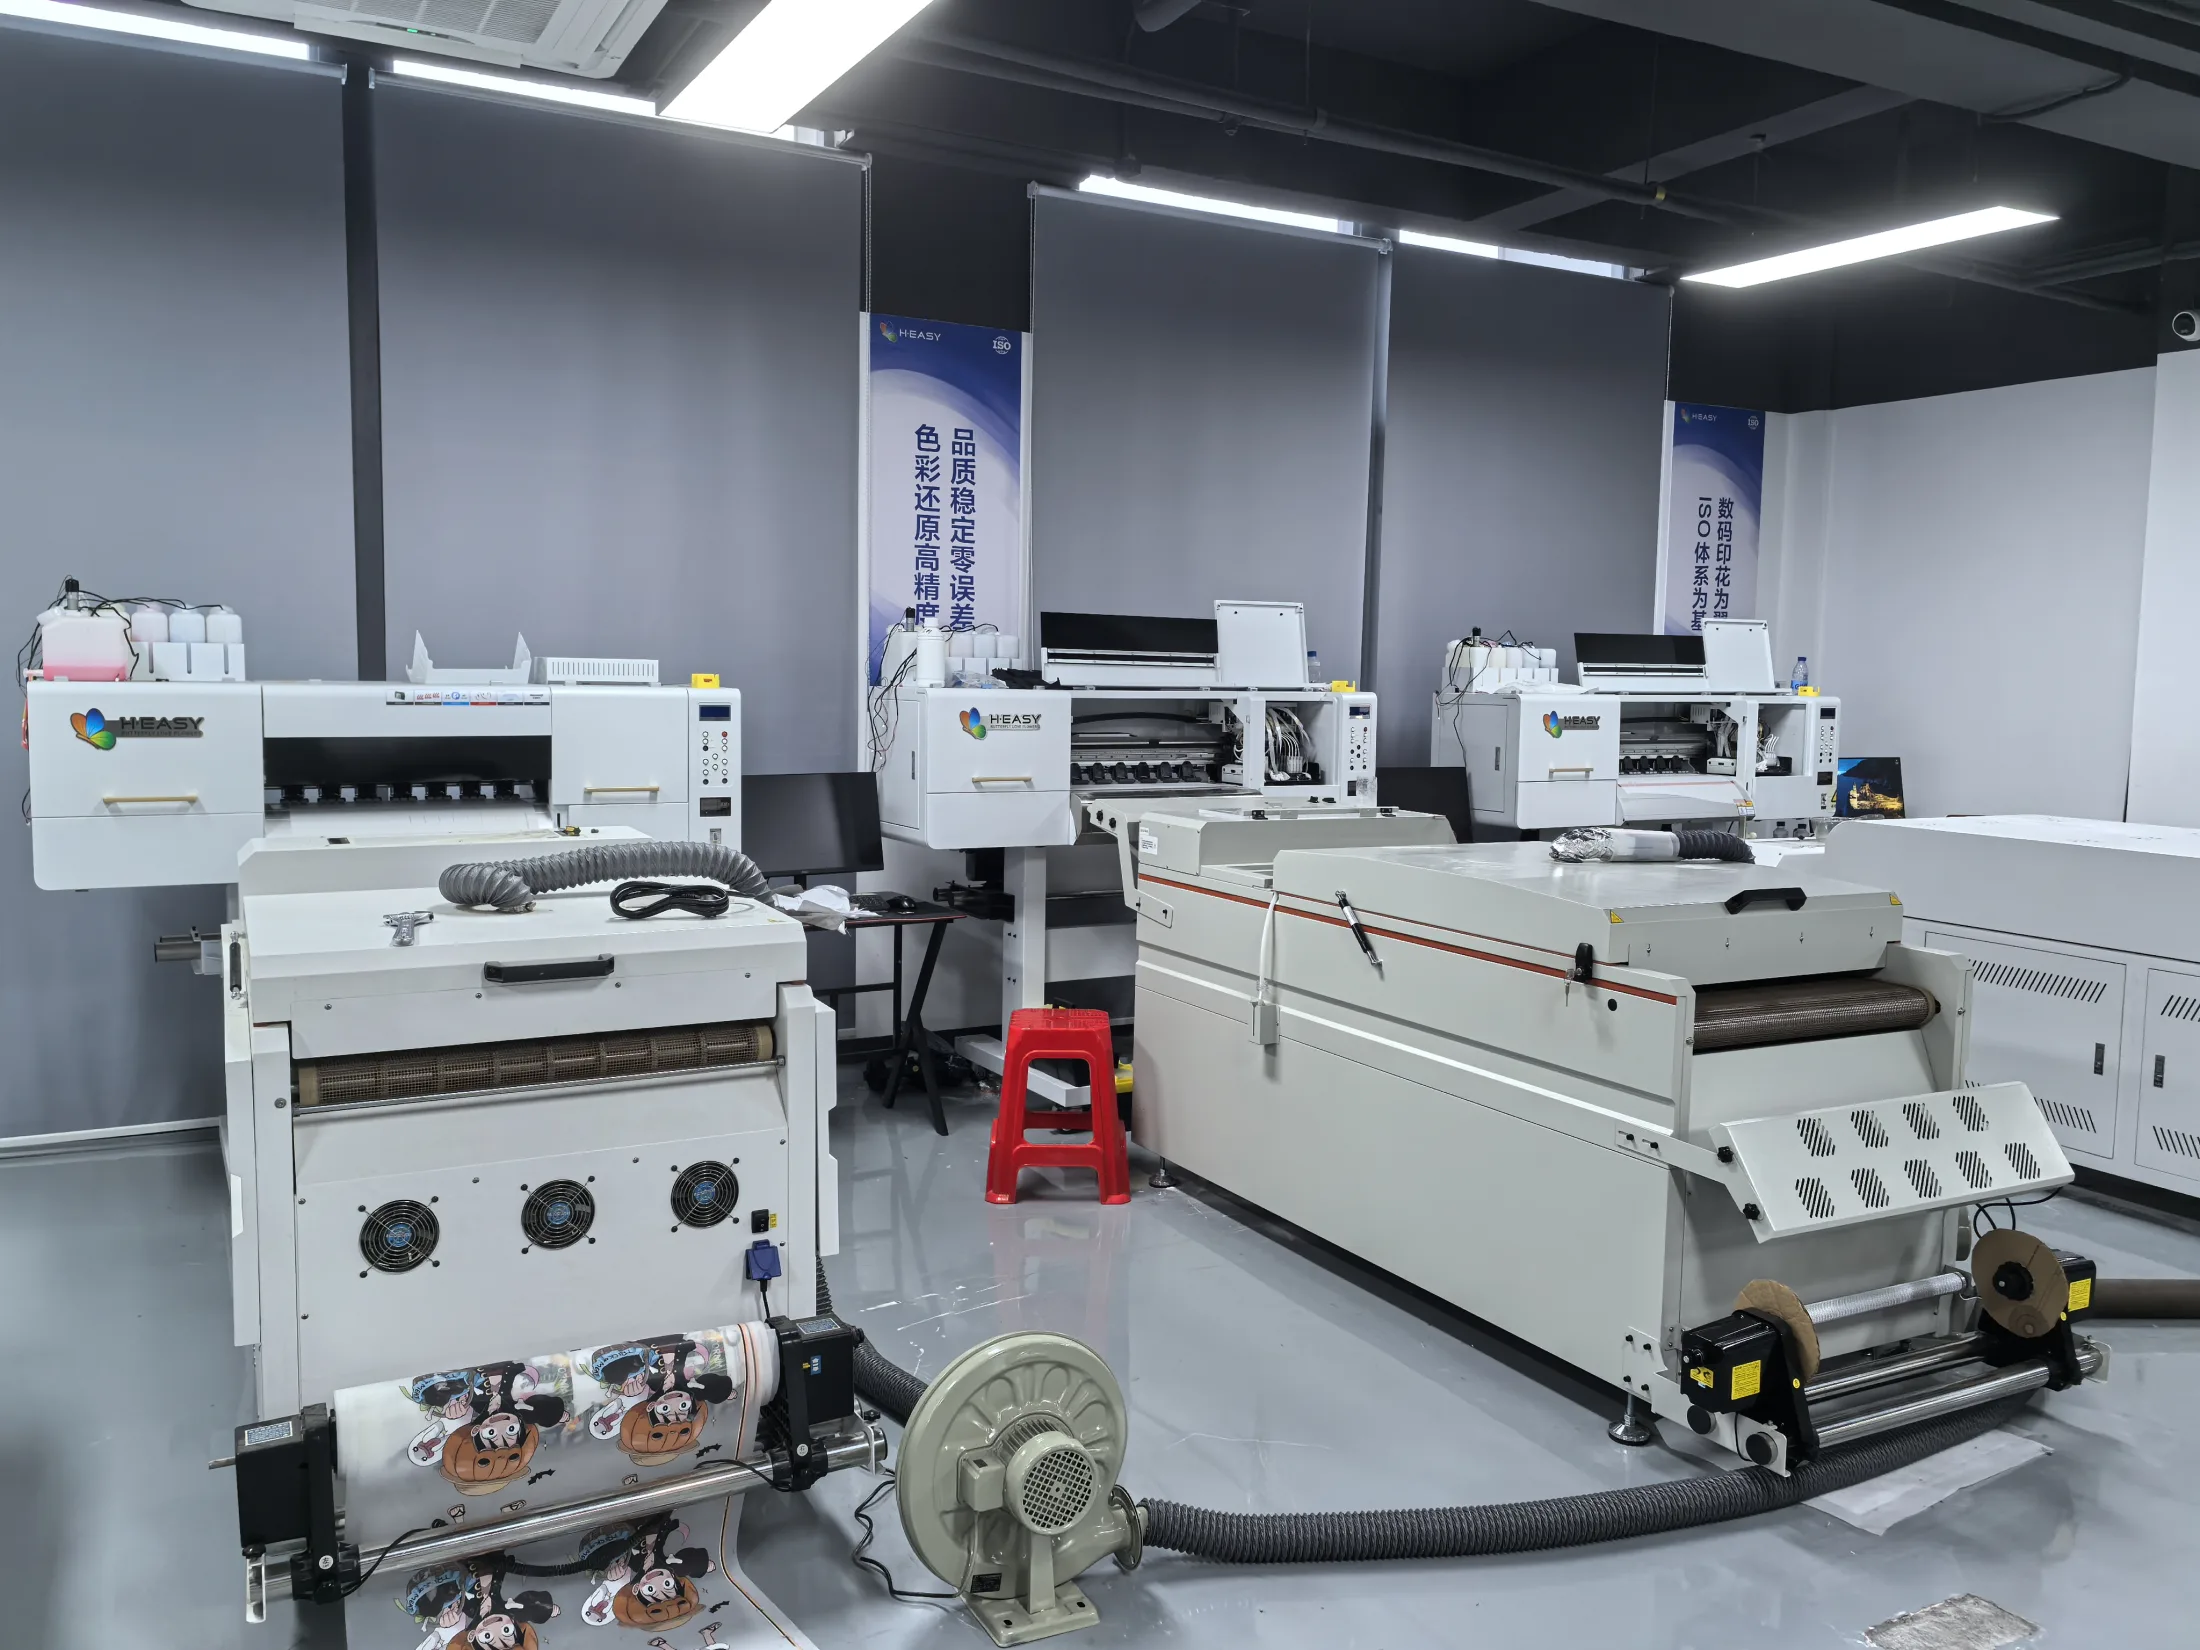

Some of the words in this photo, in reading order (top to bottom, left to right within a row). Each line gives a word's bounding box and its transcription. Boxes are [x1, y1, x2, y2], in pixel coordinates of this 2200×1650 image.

[992, 340, 1011, 351] ISO
[914, 423, 941, 626] 色彩还原高精度
[950, 427, 976, 631] 品质稳定零误差
